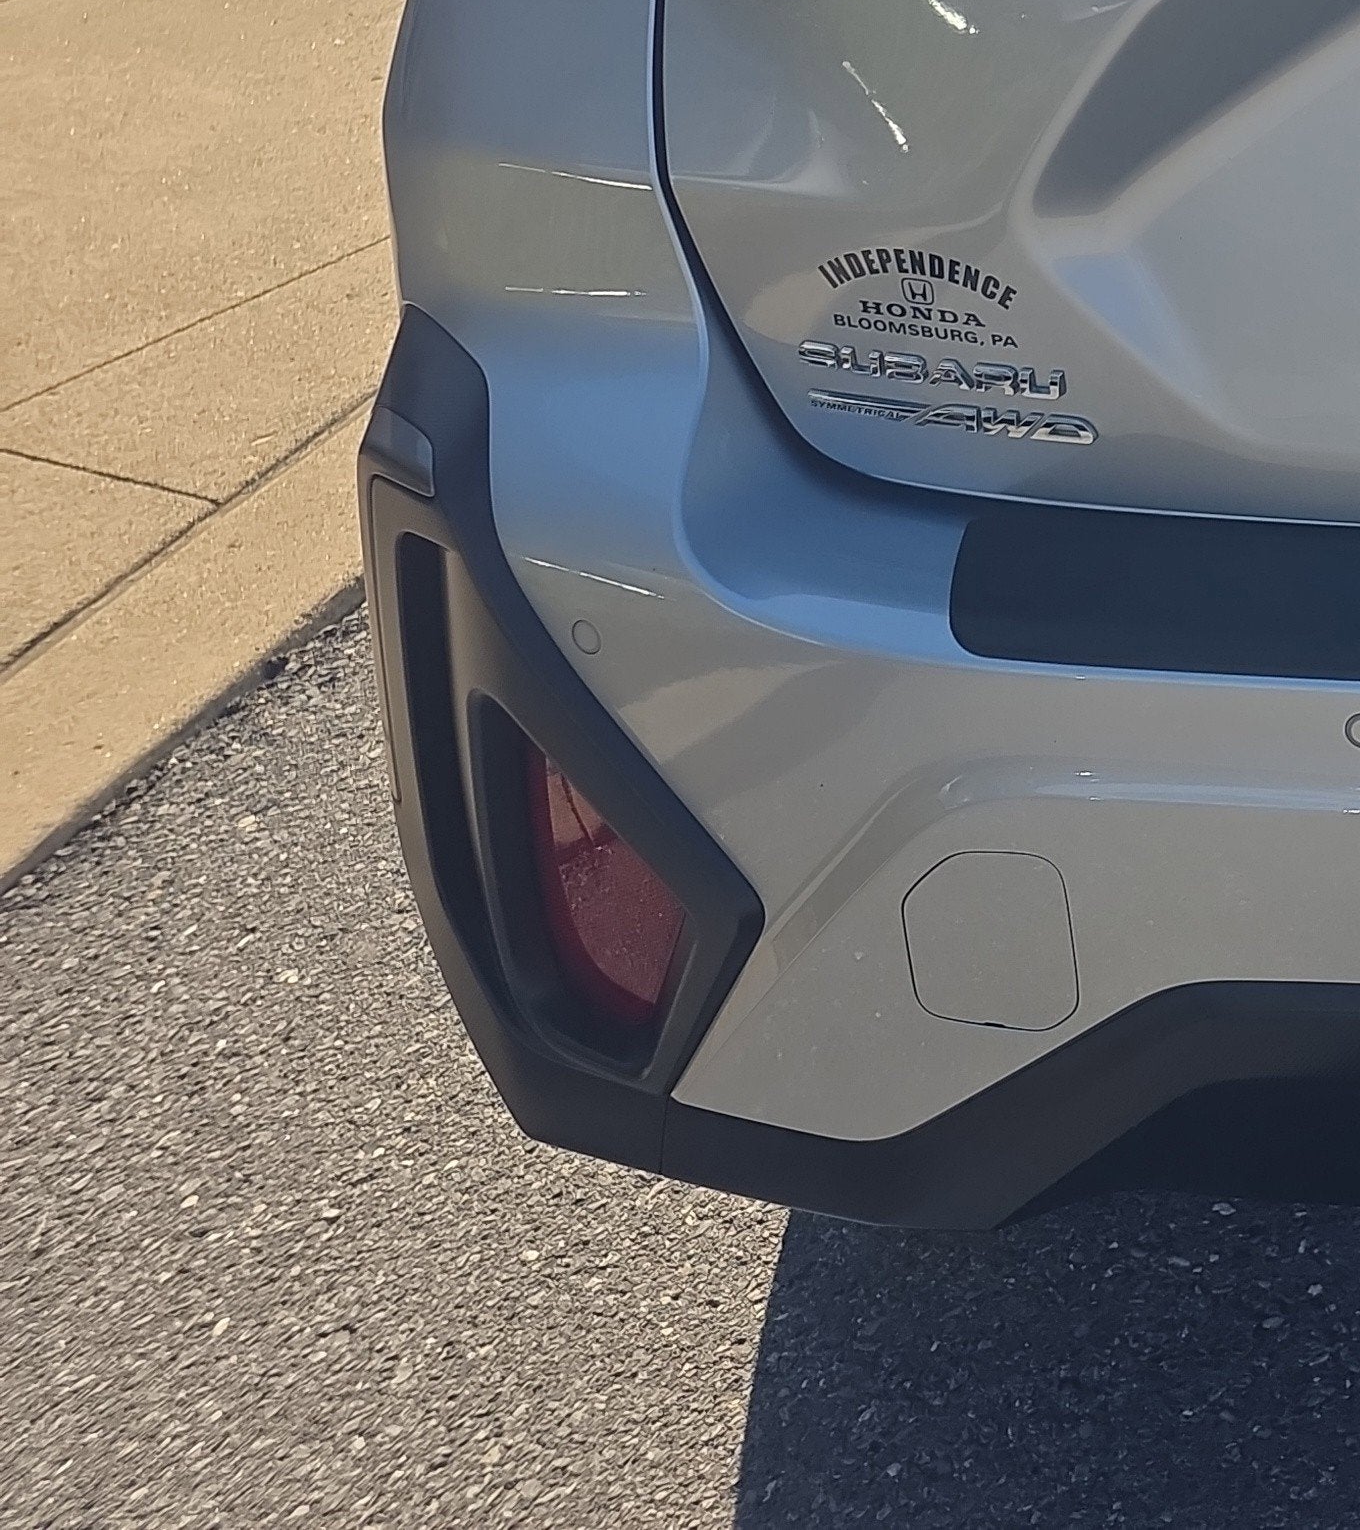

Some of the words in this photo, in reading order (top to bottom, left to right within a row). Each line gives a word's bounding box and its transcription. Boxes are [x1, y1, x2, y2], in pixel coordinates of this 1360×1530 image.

[818, 248, 1018, 310] INDEPENDENCE
[833, 313, 985, 347] BLOOMSBURG,
[991, 333, 1018, 348] PA
[858, 300, 985, 328] HONDA
[799, 340, 1067, 400] SUBARU
[809, 399, 903, 421] SYMMETRICAL
[914, 403, 1099, 445] AWD
